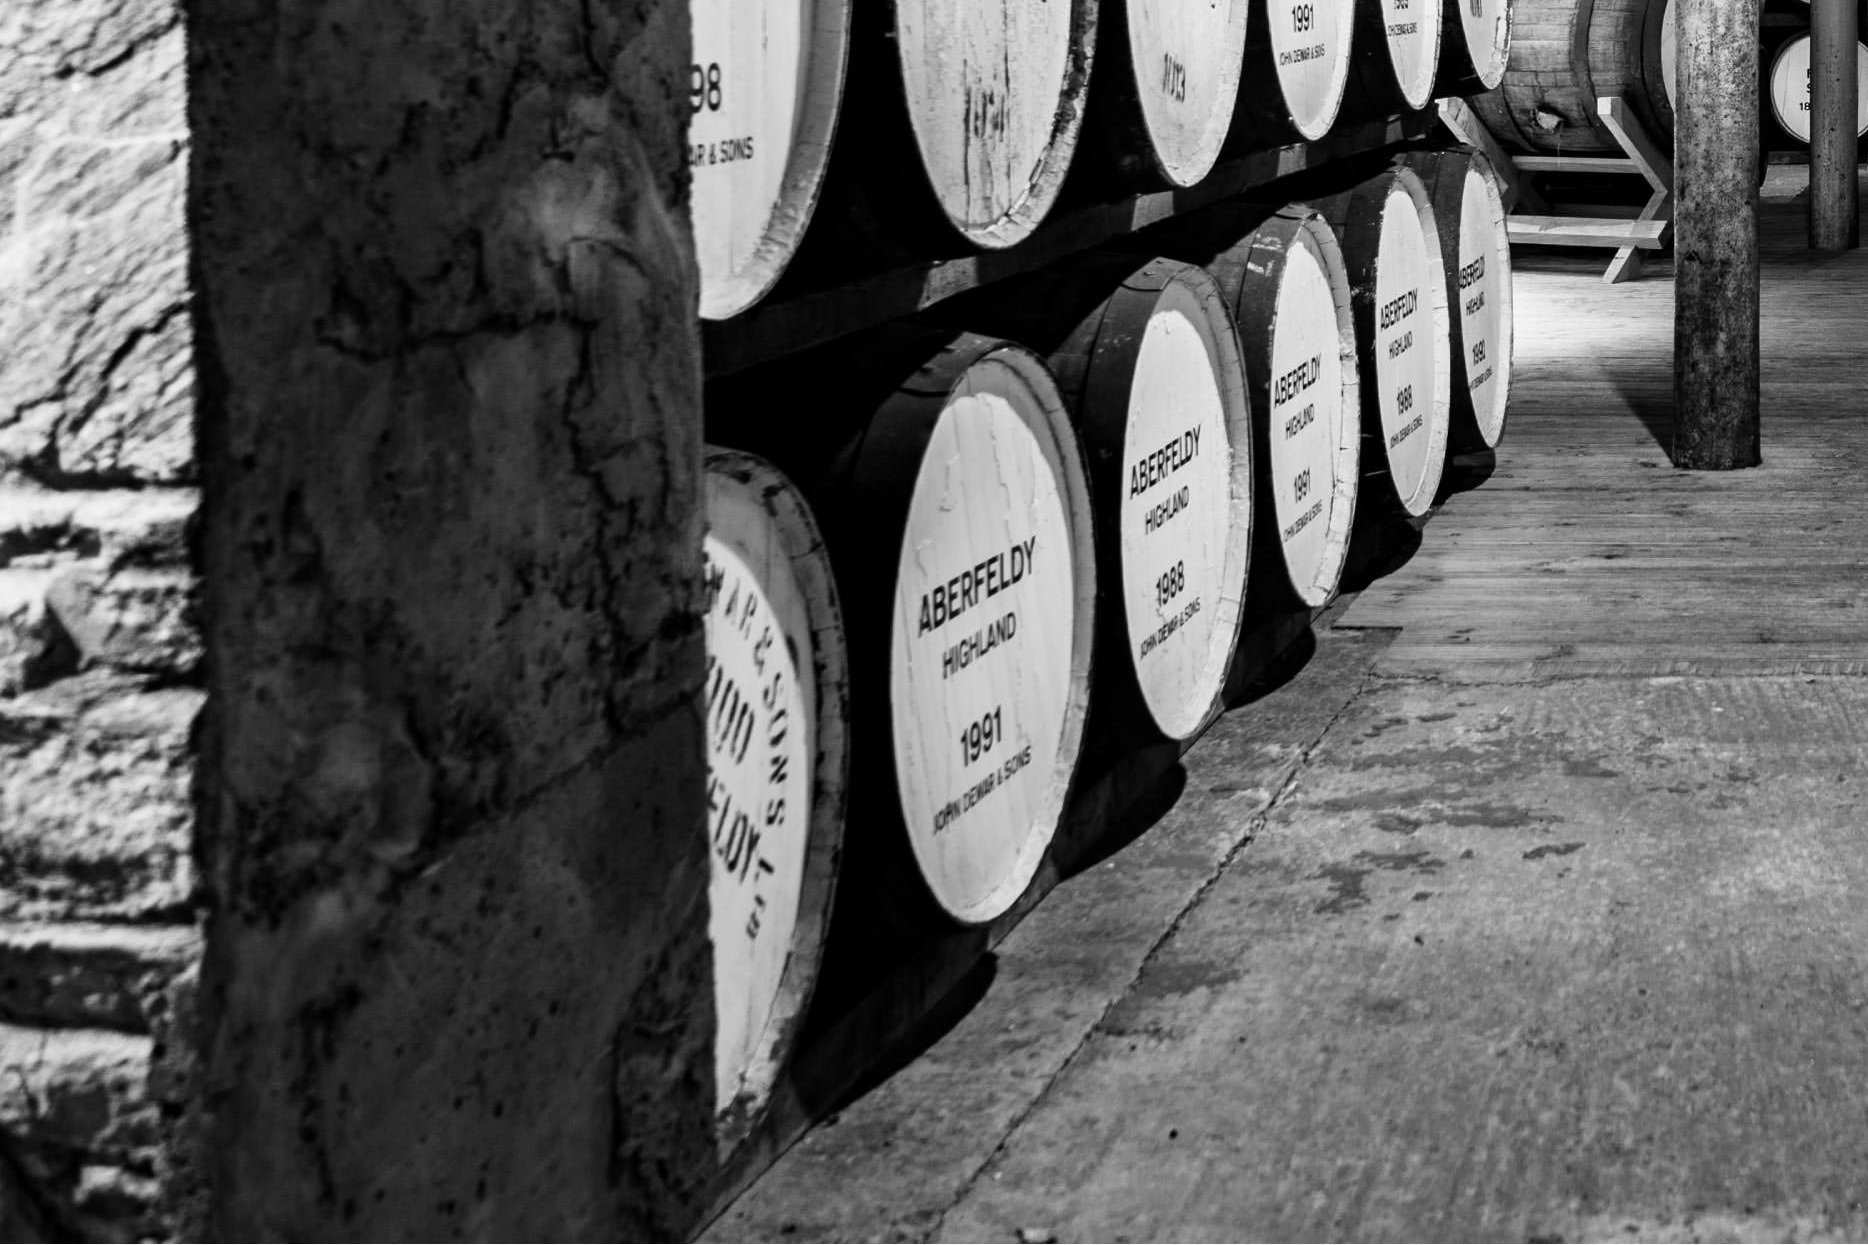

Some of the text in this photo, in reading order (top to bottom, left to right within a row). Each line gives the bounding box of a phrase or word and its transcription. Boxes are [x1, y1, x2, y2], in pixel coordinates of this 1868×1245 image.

[1292, 3, 1315, 34] 1991
[690, 62, 721, 114] 98
[720, 136, 754, 164] SONS
[1381, 287, 1418, 332] ABERFELDY
[1275, 353, 1321, 409] ABERFELDY
[1285, 403, 1315, 441] HIGHLAND
[1130, 423, 1201, 500] ABERFELDY
[1293, 466, 1310, 504] 1991
[1145, 485, 1189, 535] HIGHLAND
[704, 561, 758, 641] WAR
[919, 536, 1036, 639] ABERFELDY
[1156, 559, 1185, 607] 1988
[943, 611, 1017, 680] HIGHLAND
[960, 704, 1003, 768] 1991
[932, 796, 962, 836] JOHN
[962, 771, 996, 811] DEWAR
[1004, 744, 1032, 783] SONS
